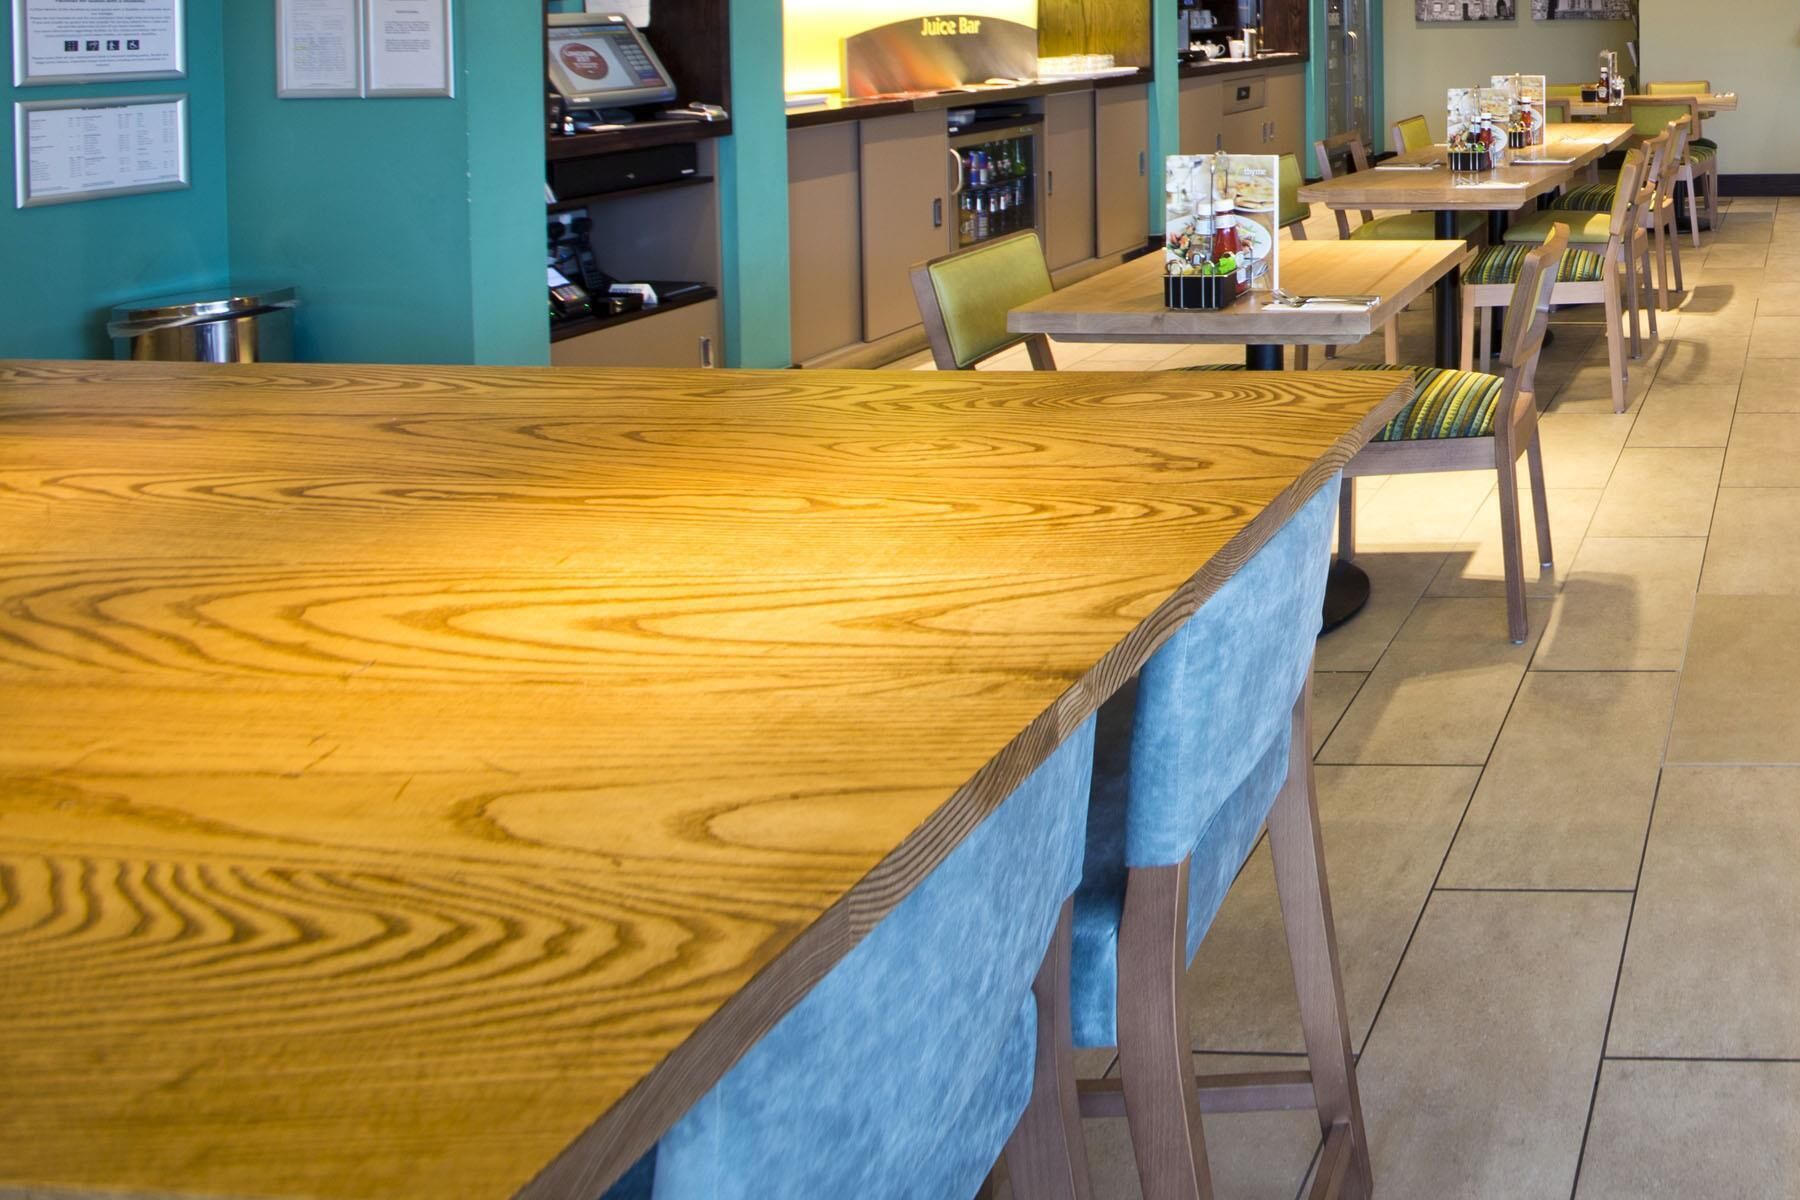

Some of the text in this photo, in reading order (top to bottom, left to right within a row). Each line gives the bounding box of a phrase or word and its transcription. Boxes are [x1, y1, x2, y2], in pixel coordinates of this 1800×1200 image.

[921, 16, 981, 36] Juice Bar
[1243, 167, 1267, 177] thyme
